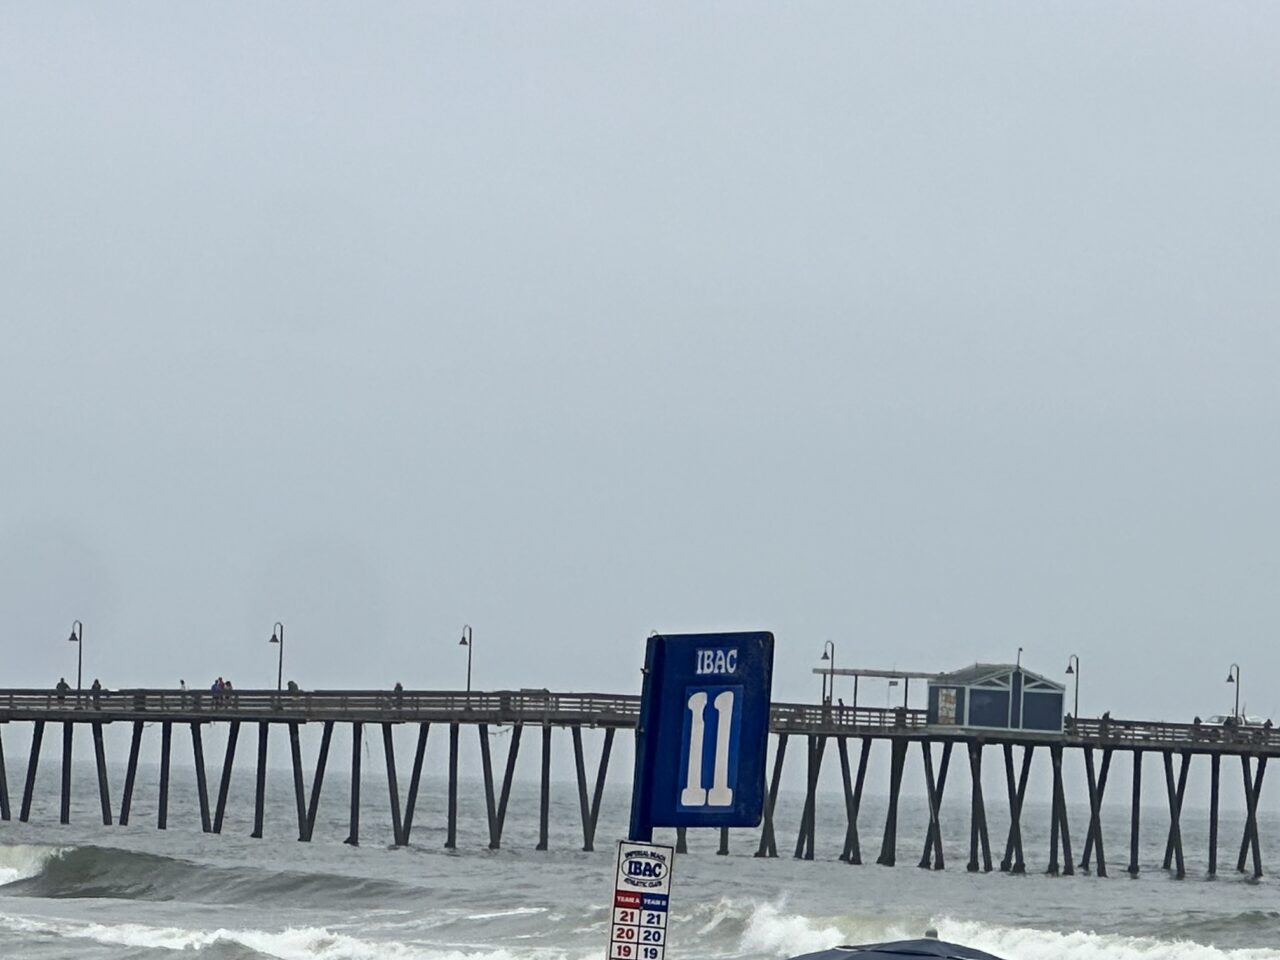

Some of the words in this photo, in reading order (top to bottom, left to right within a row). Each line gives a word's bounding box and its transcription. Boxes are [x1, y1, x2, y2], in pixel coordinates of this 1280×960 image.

[696, 649, 738, 674] IBAC
[681, 691, 734, 806] 11
[628, 861, 662, 877] IBAC
[619, 910, 634, 922] 21
[646, 913, 661, 925] 21
[616, 927, 635, 940] 20
[643, 930, 661, 942] 20
[617, 945, 631, 957] 19
[643, 947, 658, 959] 19
